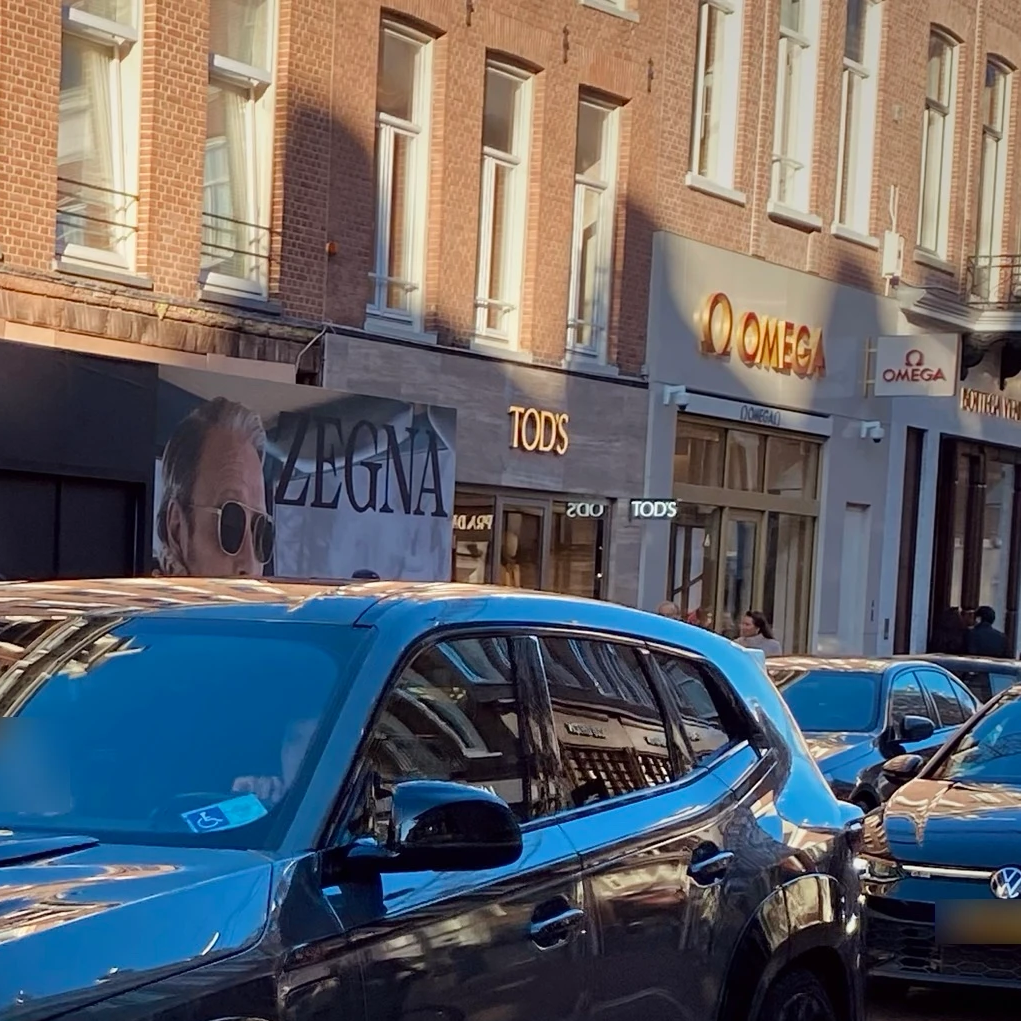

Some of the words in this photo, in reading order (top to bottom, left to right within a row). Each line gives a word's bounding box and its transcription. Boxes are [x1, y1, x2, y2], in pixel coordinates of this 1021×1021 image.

[737, 311, 826, 378] OMEGA
[882, 368, 947, 382] OMEGA
[509, 405, 569, 455] TOD'S
[274, 411, 449, 517] ZEGNA
[631, 500, 677, 517] TOD'S
